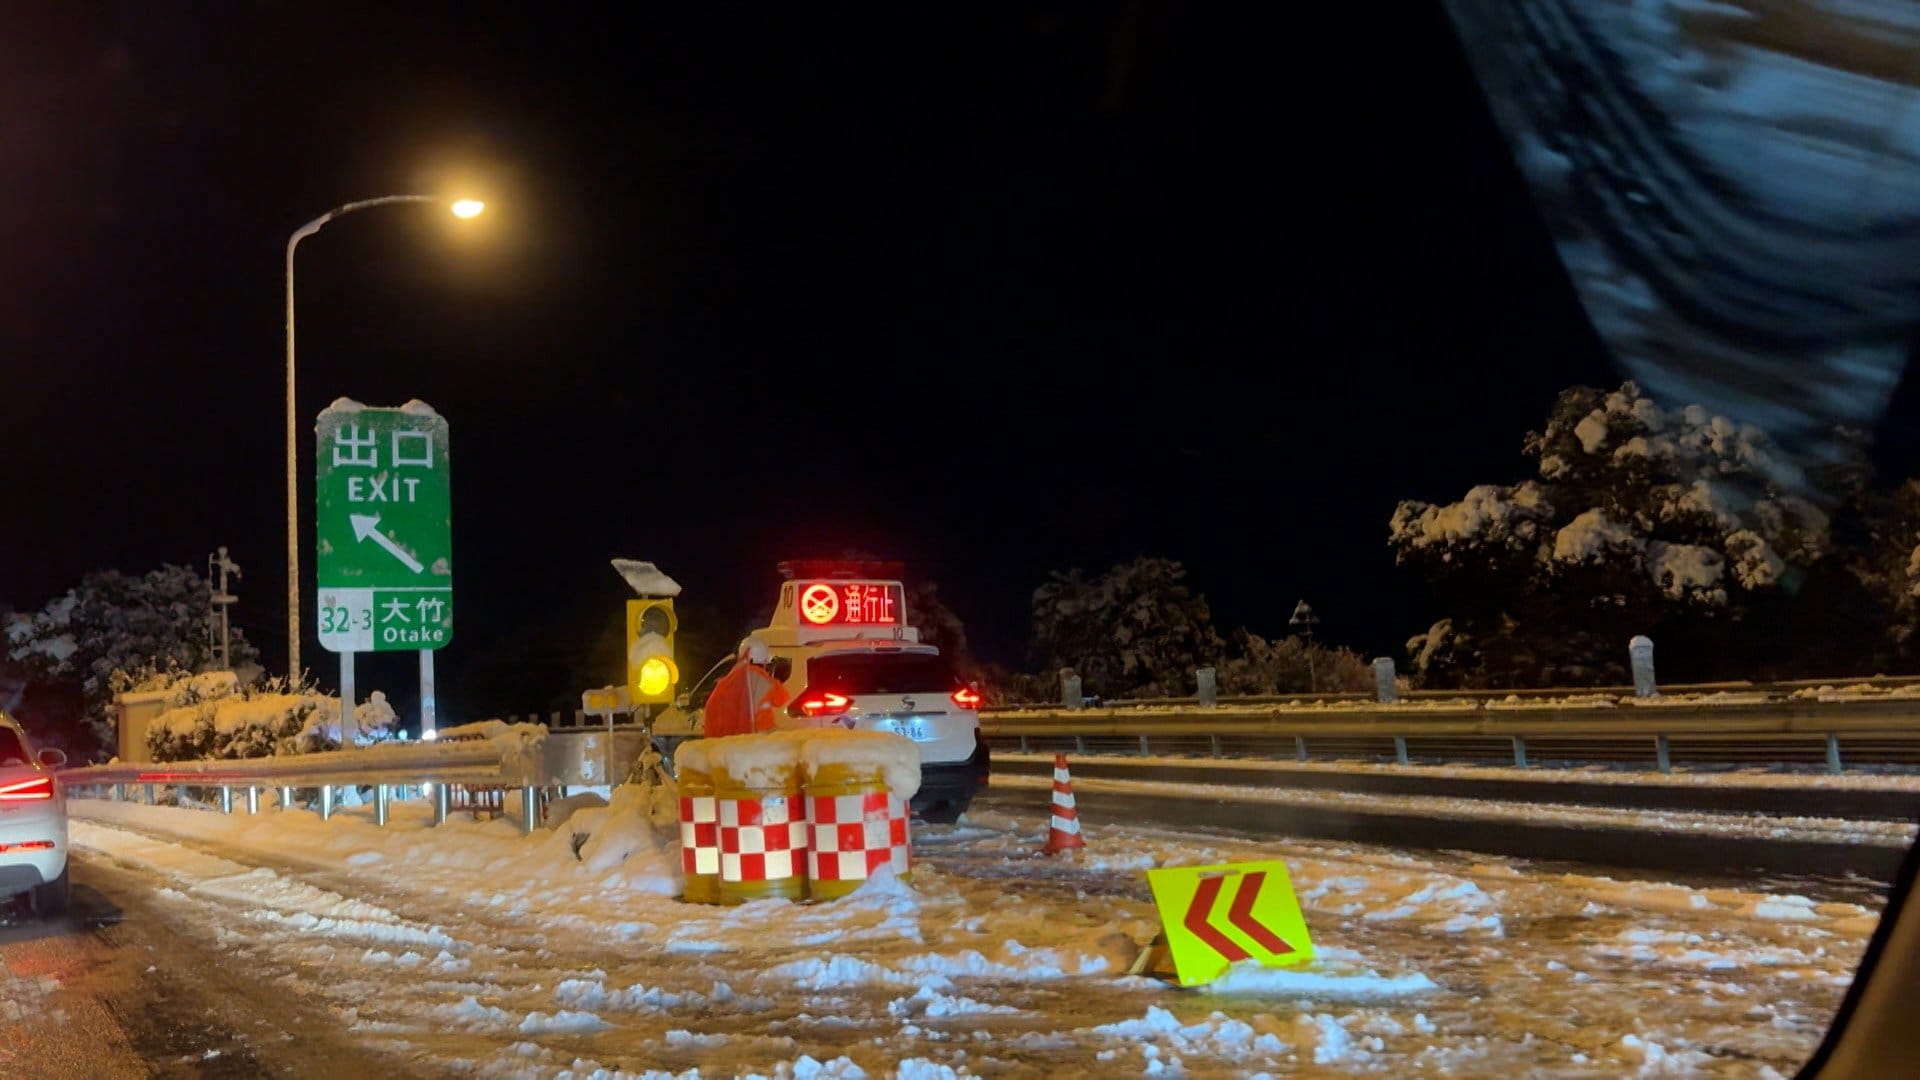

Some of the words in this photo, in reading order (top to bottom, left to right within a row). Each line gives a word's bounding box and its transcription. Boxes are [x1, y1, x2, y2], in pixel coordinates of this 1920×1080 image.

[333, 423, 433, 468] 出口
[348, 477, 420, 502] EXIT
[381, 598, 444, 623] 大竹
[844, 585, 895, 622] 通行止
[321, 607, 372, 633] 32-3
[383, 627, 443, 643] Otake
